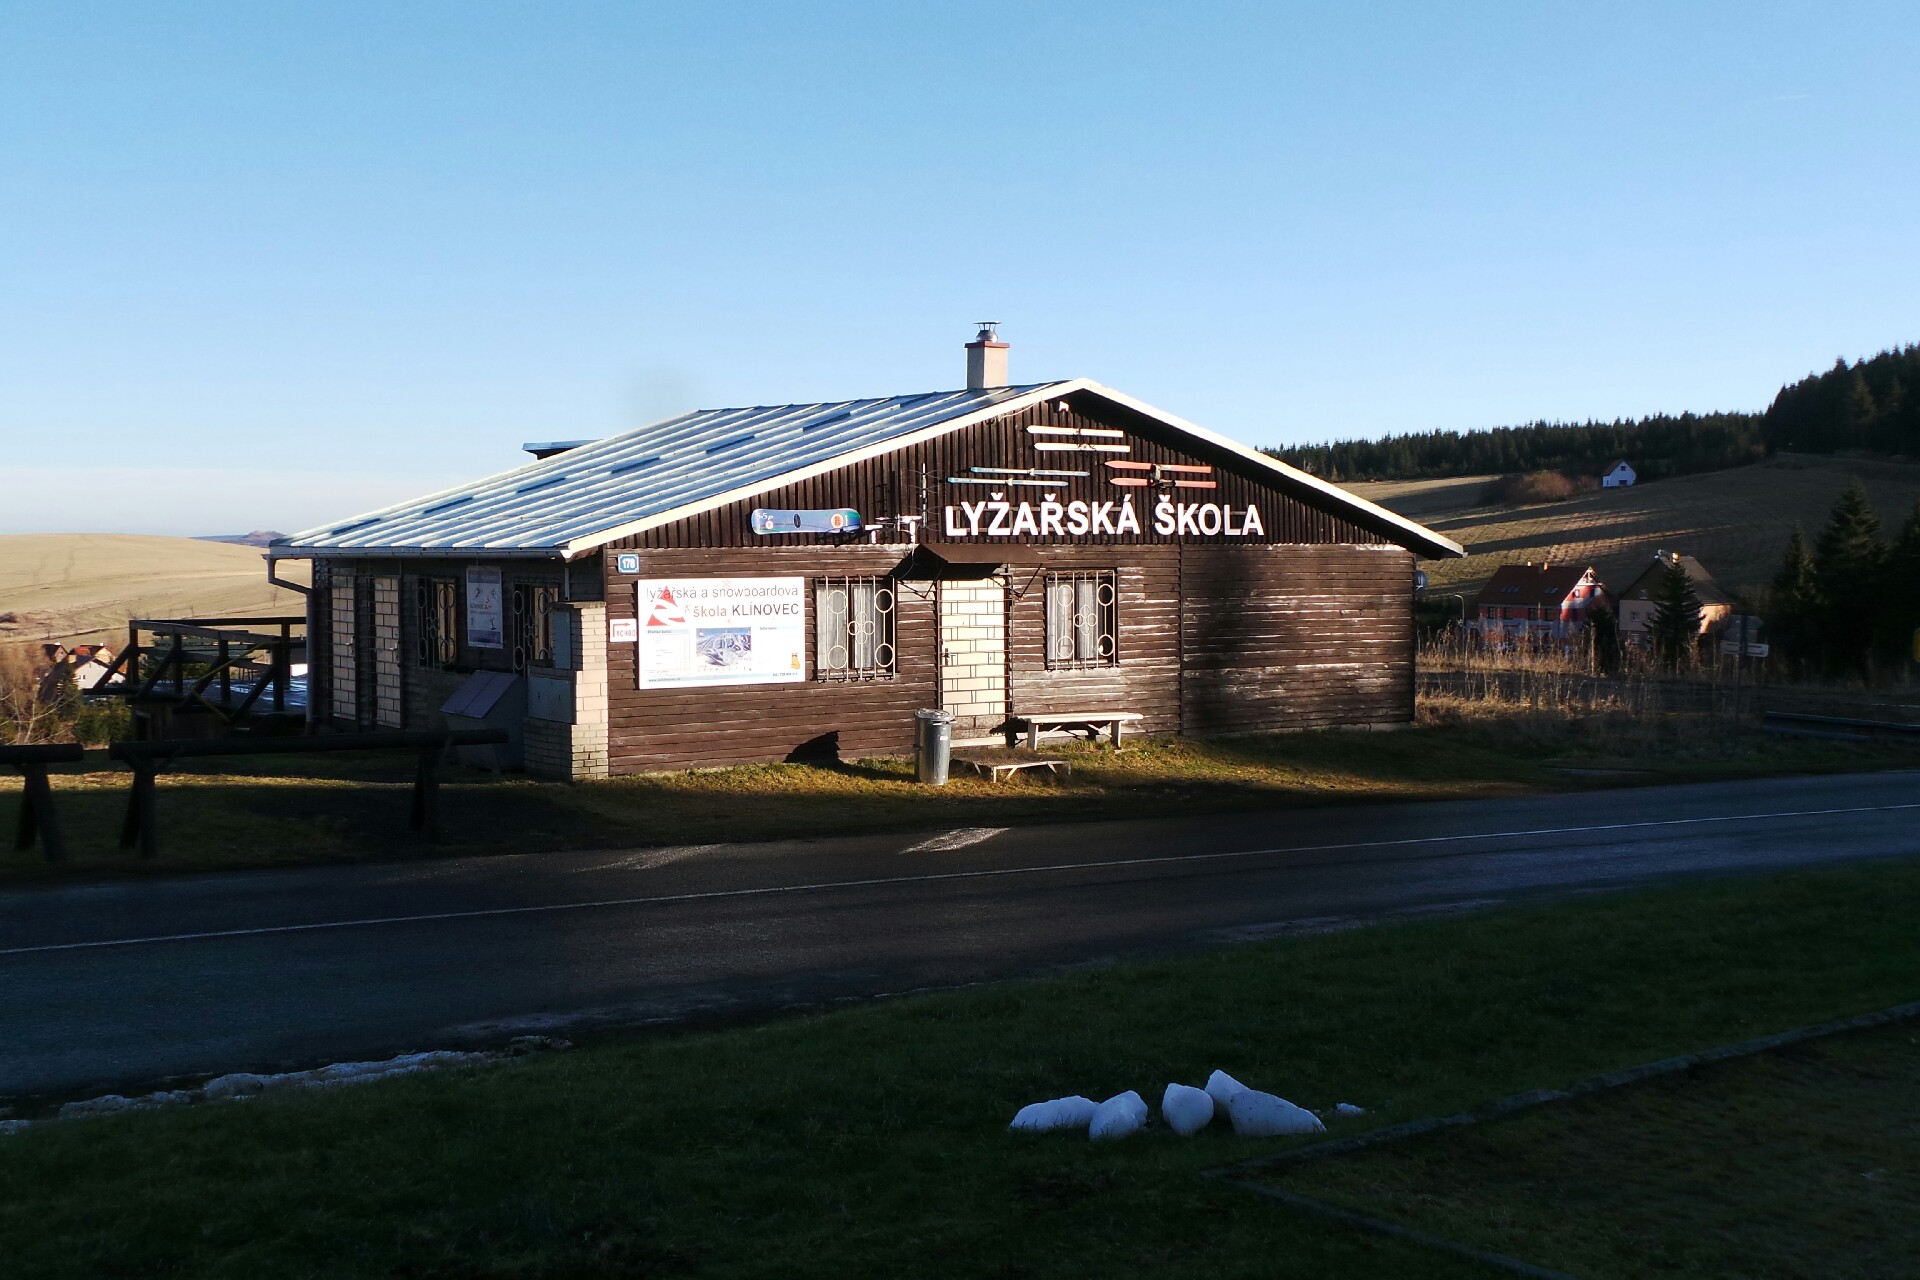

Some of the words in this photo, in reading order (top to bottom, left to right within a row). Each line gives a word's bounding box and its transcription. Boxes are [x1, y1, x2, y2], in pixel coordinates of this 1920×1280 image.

[945, 492, 1141, 537] LYŽAŘSKÁ
[1154, 494, 1265, 536] ŠKOLA
[621, 557, 636, 569] 178
[646, 586, 697, 603] lyžařská
[701, 588, 708, 598] a
[712, 584, 799, 598] snowboardová
[693, 605, 727, 618] škola
[732, 602, 799, 616] KLÍNOVEC
